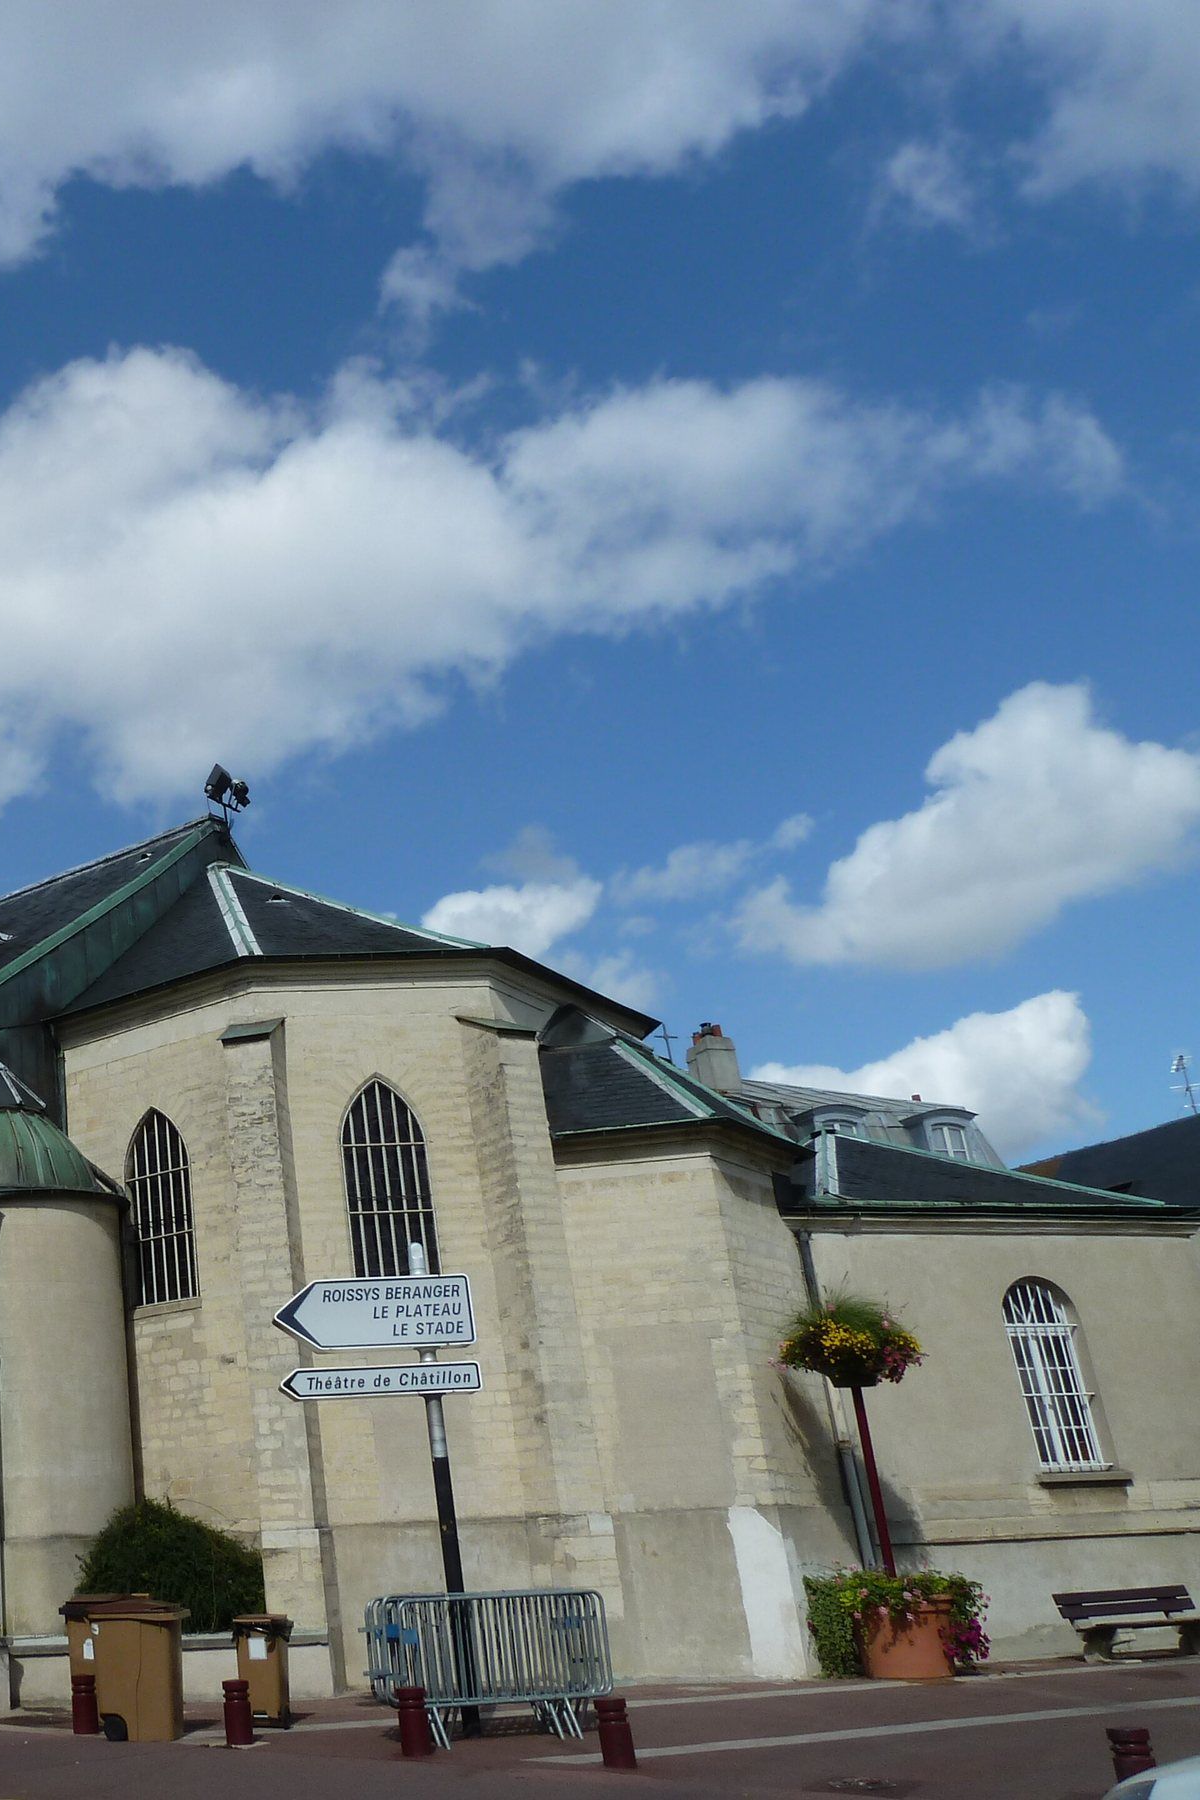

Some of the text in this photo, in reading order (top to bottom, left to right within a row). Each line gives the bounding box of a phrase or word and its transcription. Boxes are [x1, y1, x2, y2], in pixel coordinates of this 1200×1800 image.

[322, 1284, 460, 1303] ROISSYS BERANGER
[373, 1303, 462, 1319] LE PLATEAU
[393, 1321, 464, 1337] LE STADE
[307, 1371, 471, 1391] Théâtre de Châtillon
